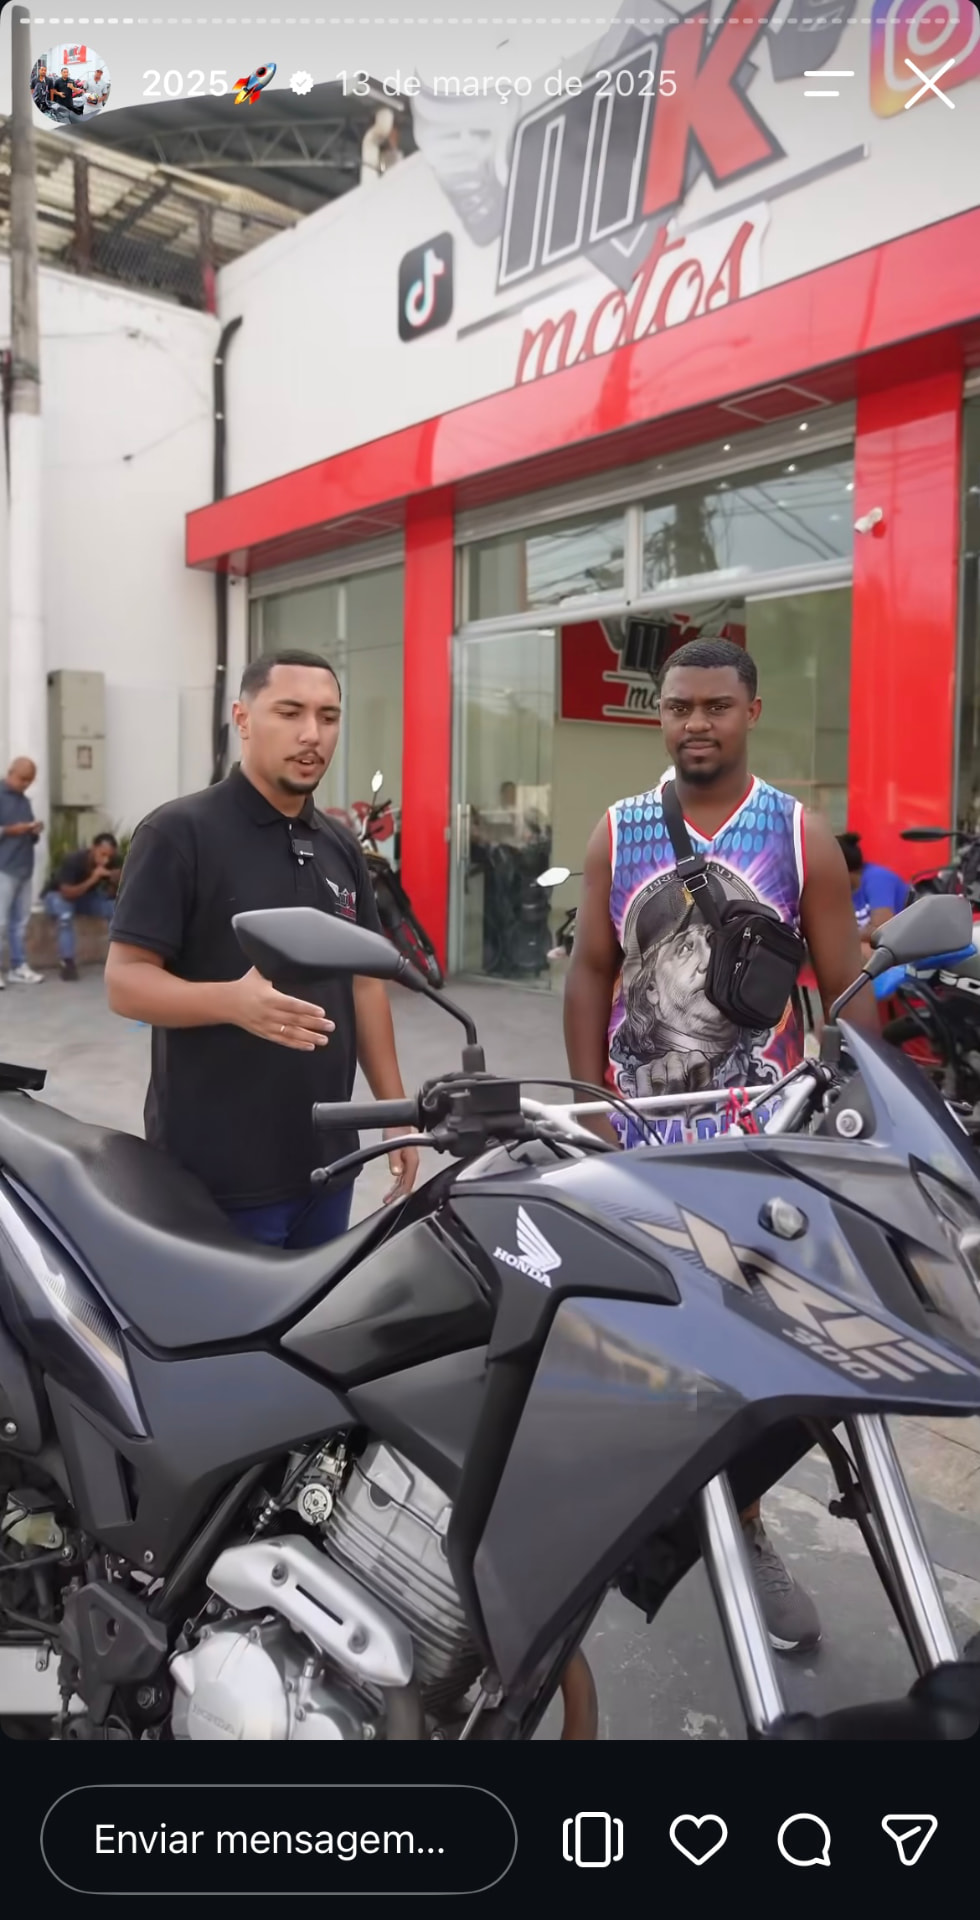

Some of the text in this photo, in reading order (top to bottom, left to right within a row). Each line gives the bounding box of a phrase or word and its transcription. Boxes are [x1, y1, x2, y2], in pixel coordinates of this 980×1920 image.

[514, 220, 755, 389] motos
[492, 1246, 552, 1289] HONDA
[621, 1202, 970, 1383] XRE
[781, 1327, 882, 1380] 300
